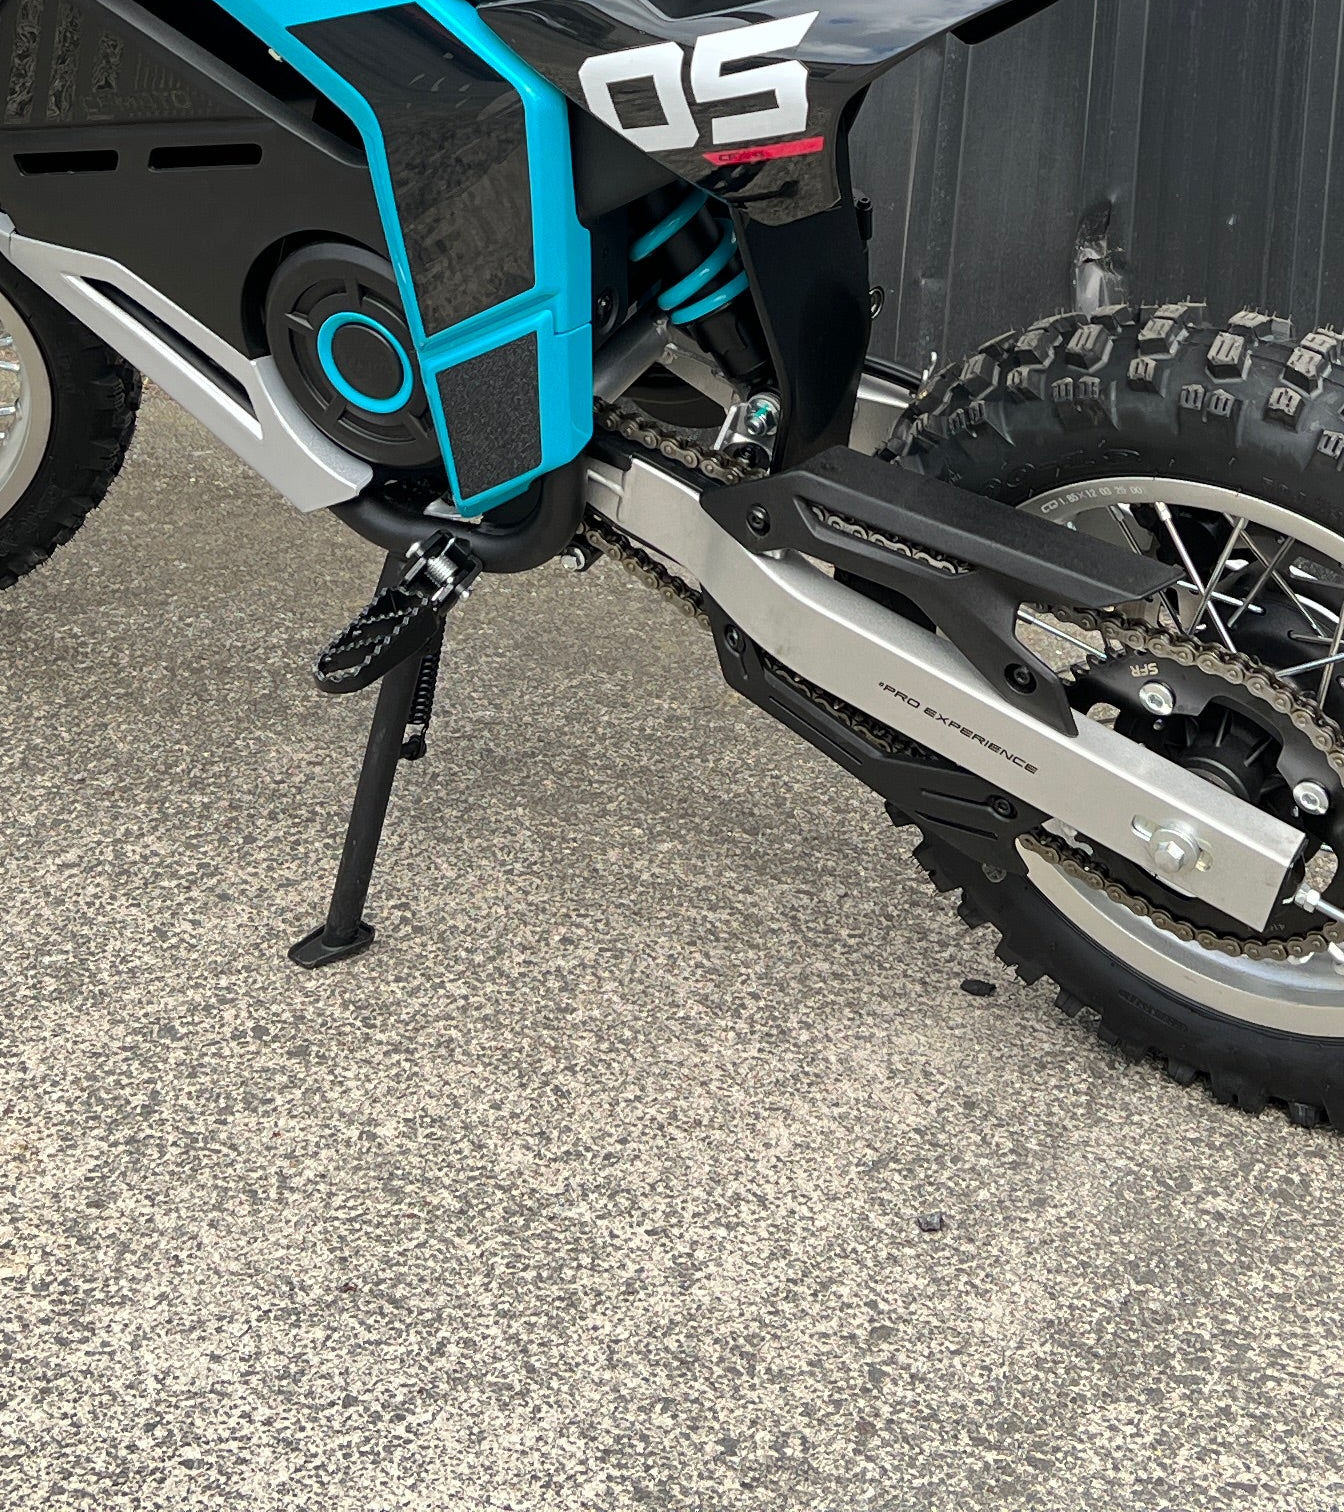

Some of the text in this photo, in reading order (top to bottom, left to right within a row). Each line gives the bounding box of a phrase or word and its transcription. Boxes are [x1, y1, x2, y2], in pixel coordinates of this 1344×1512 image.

[577, 9, 820, 153] 05
[1129, 662, 1159, 678] SFR
[923, 707, 1039, 775] EXPERIENCE
